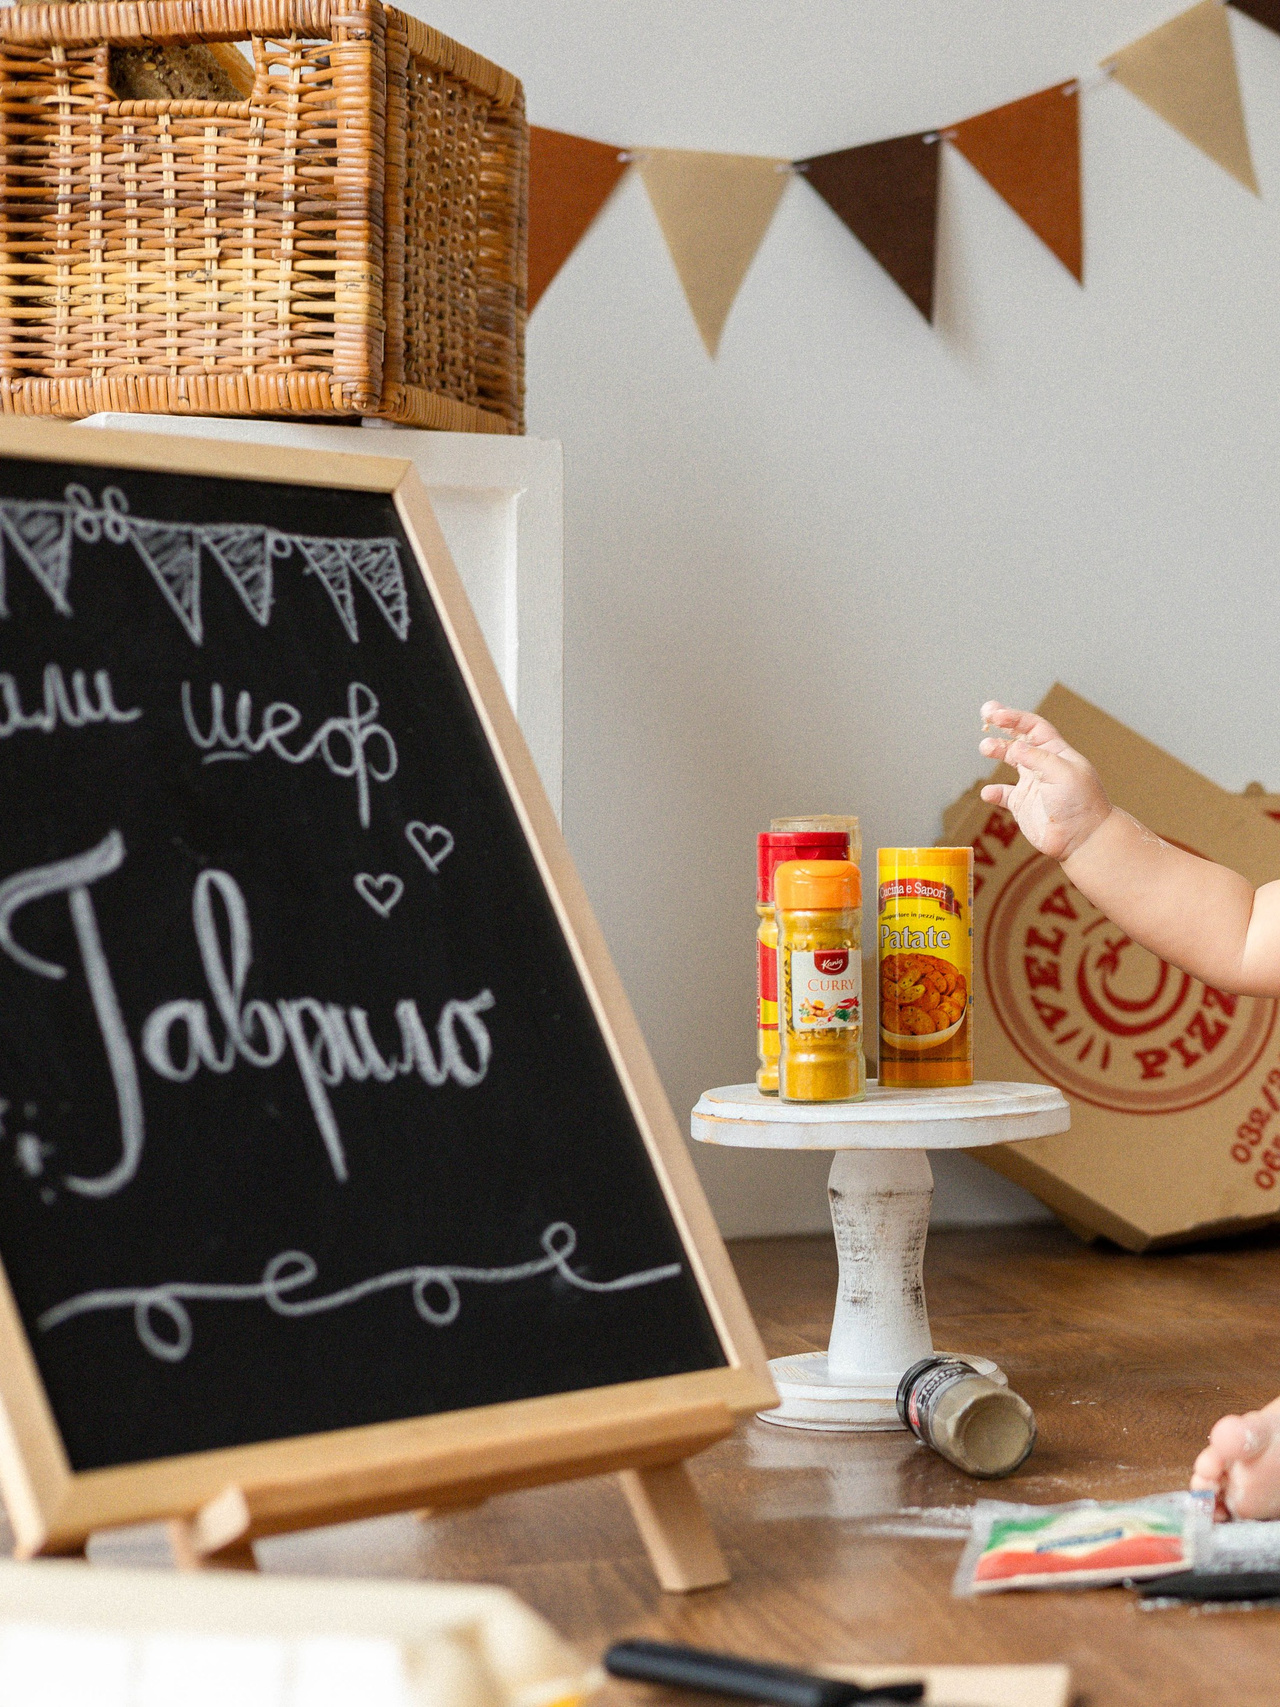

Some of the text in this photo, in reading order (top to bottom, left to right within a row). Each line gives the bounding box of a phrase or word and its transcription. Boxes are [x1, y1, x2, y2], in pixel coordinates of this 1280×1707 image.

[181, 680, 399, 830] шеф
[880, 882, 905, 899] Cucina
[906, 884, 913, 894] e
[914, 881, 948, 900] Sapori
[880, 924, 951, 949] Patate
[0, 828, 497, 1198] Гаврило
[808, 979, 856, 993] CURRY
[1133, 985, 1239, 1081] PIZZ
